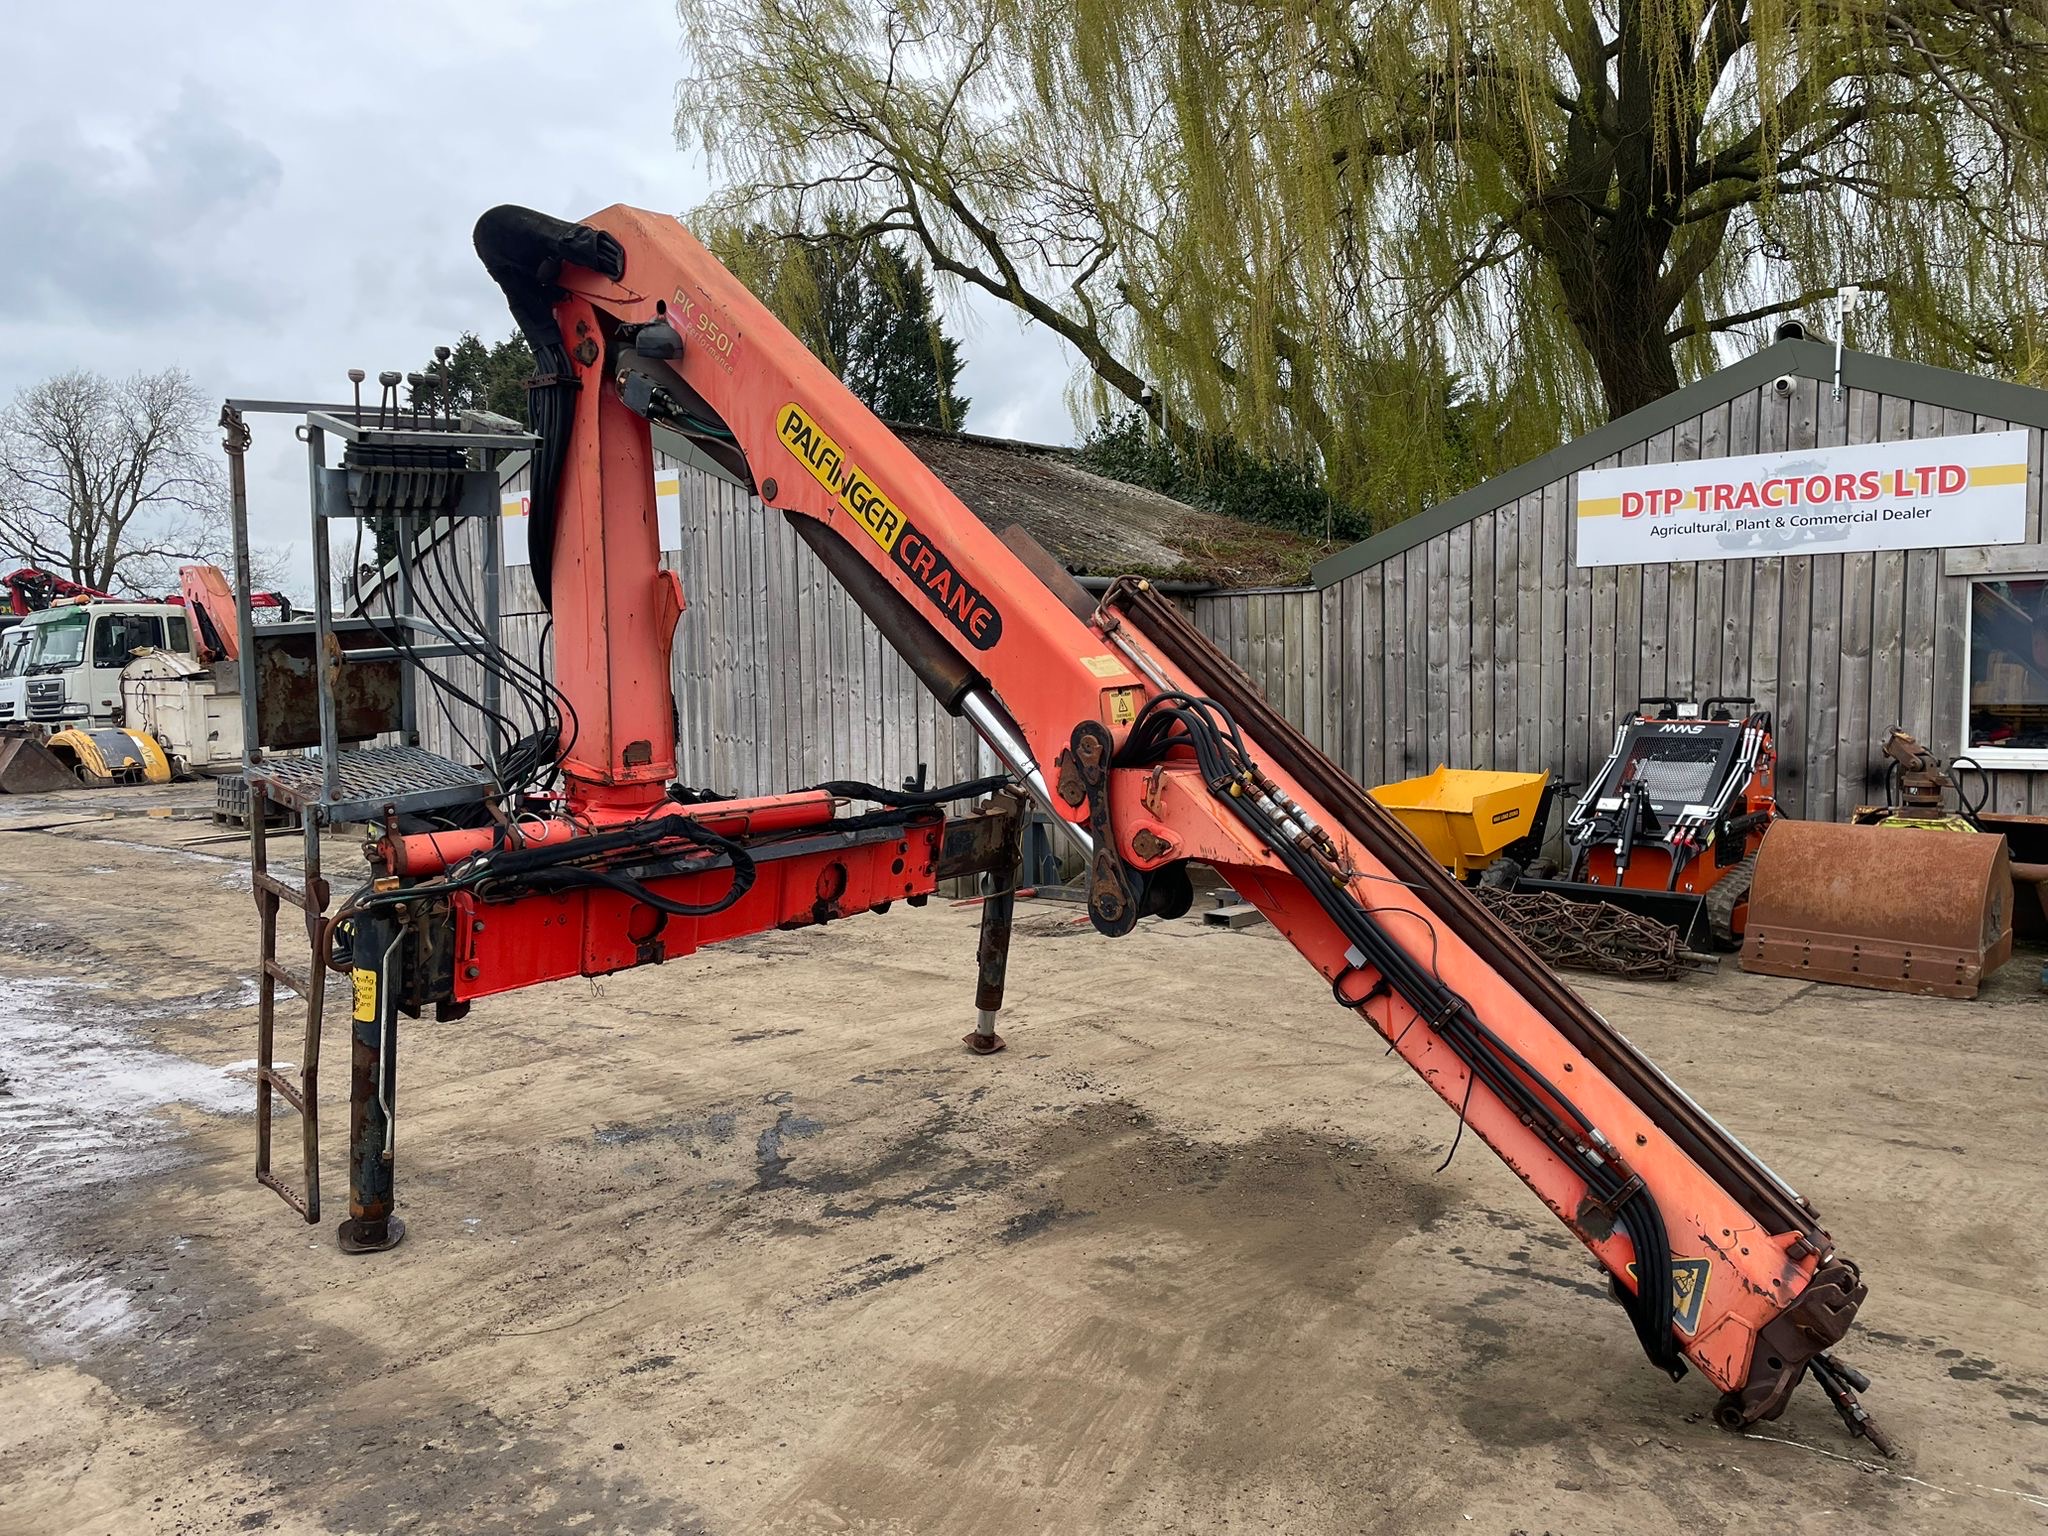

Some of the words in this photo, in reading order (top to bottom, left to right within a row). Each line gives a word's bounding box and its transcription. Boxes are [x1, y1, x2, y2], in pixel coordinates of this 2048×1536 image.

[673, 289, 695, 318] PK
[686, 322, 734, 374] Performance
[1621, 488, 1684, 518] DTP
[1694, 471, 1881, 512] TRACTORS
[1894, 464, 1967, 497] LTD
[782, 409, 899, 543] PALFINGER
[900, 534, 993, 639] CRANE
[1650, 520, 1732, 538] Agricultural,
[1736, 517, 1771, 531] Plant
[1774, 516, 1786, 528] &
[1789, 509, 1878, 526] Commercial
[1882, 506, 1932, 521] Dealer
